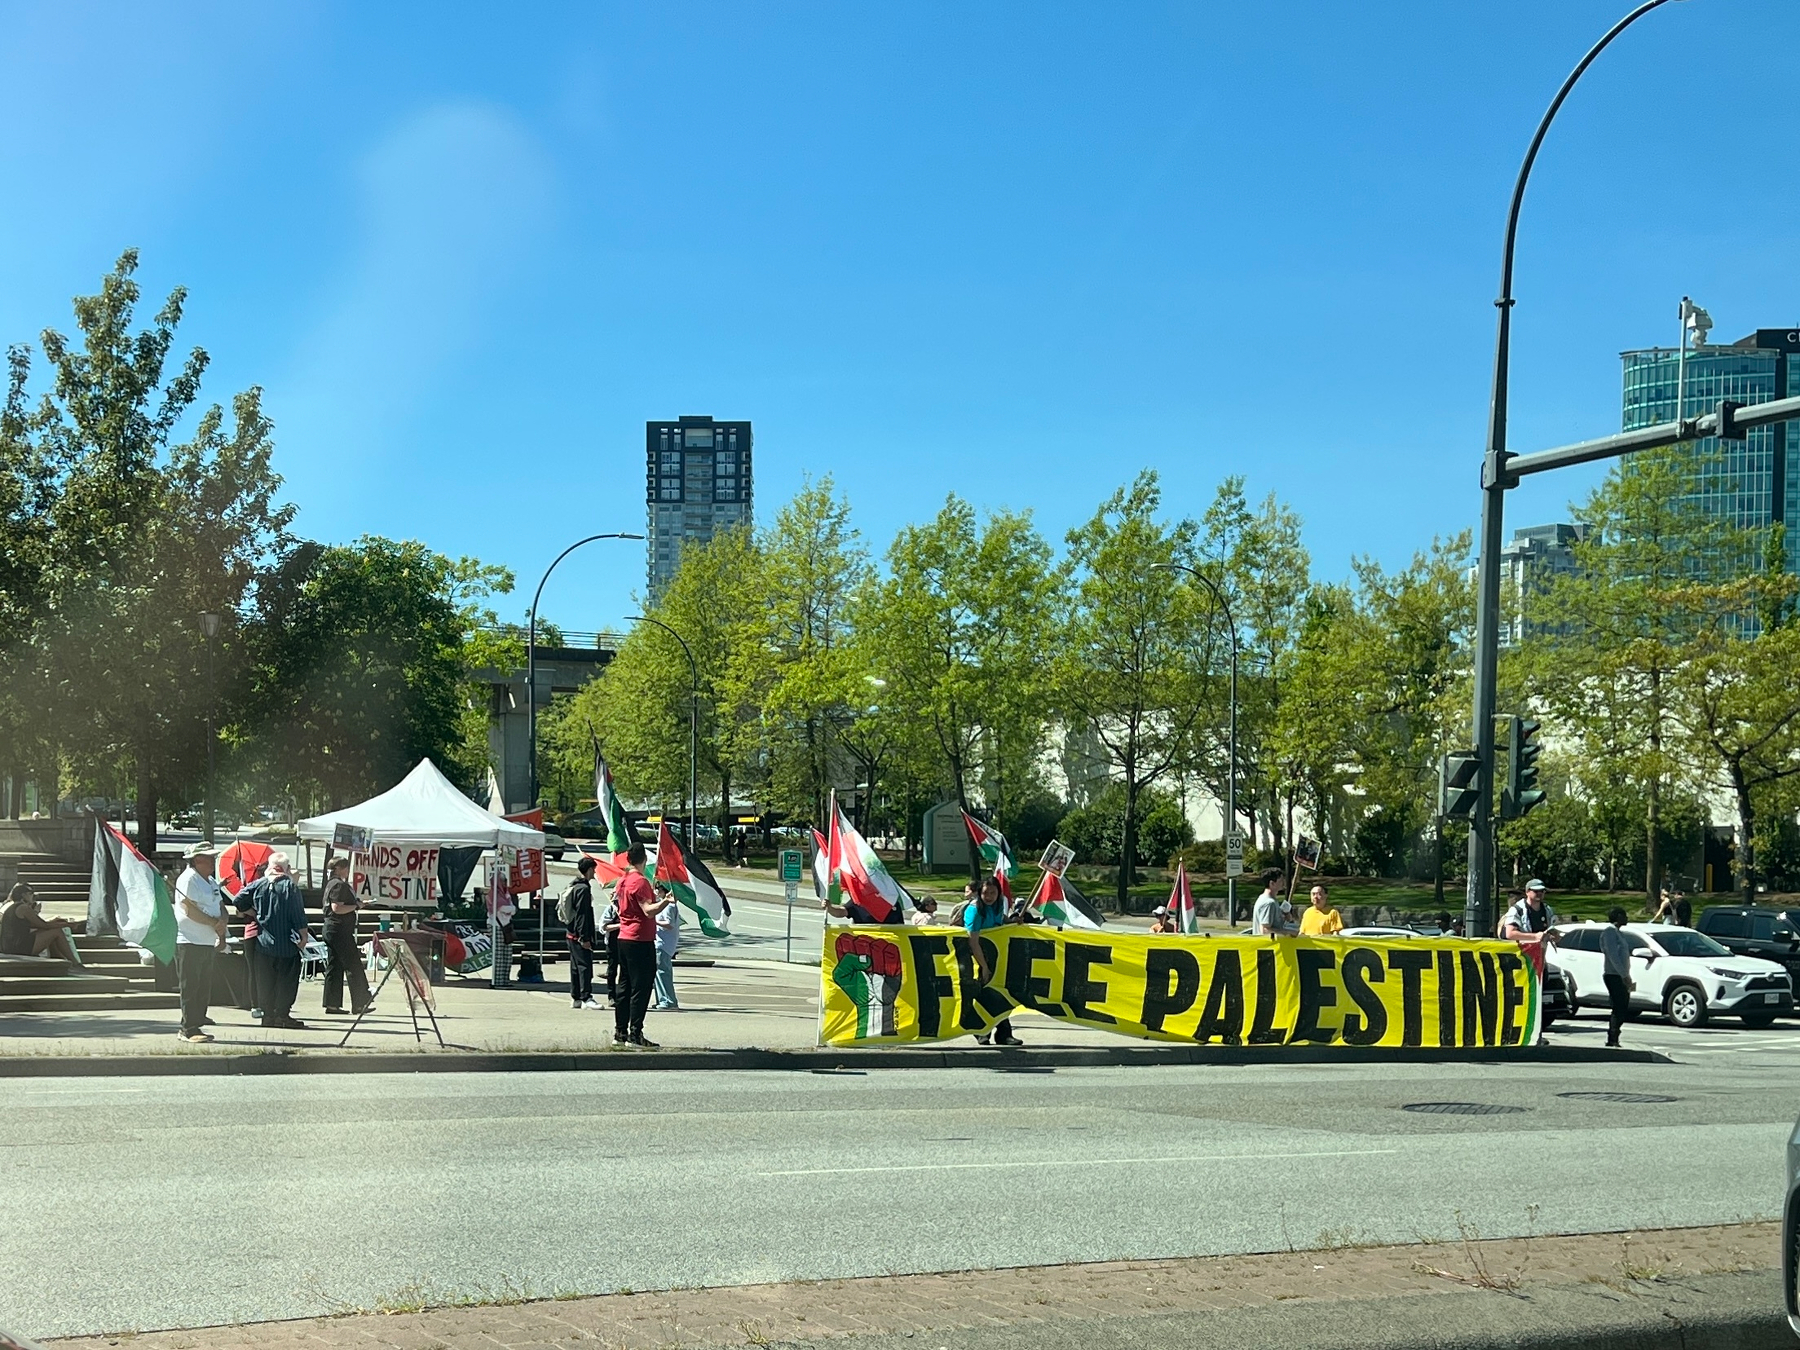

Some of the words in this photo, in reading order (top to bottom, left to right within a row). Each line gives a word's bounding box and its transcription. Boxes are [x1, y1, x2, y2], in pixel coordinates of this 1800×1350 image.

[1229, 838, 1241, 849] 50
[355, 845, 402, 869] HANDS
[406, 849, 439, 871] OFF
[353, 872, 437, 901] PALESTINE
[460, 952, 493, 972] PALES
[908, 935, 1118, 1037] FREE
[1139, 947, 1523, 1046] PALESTINE
